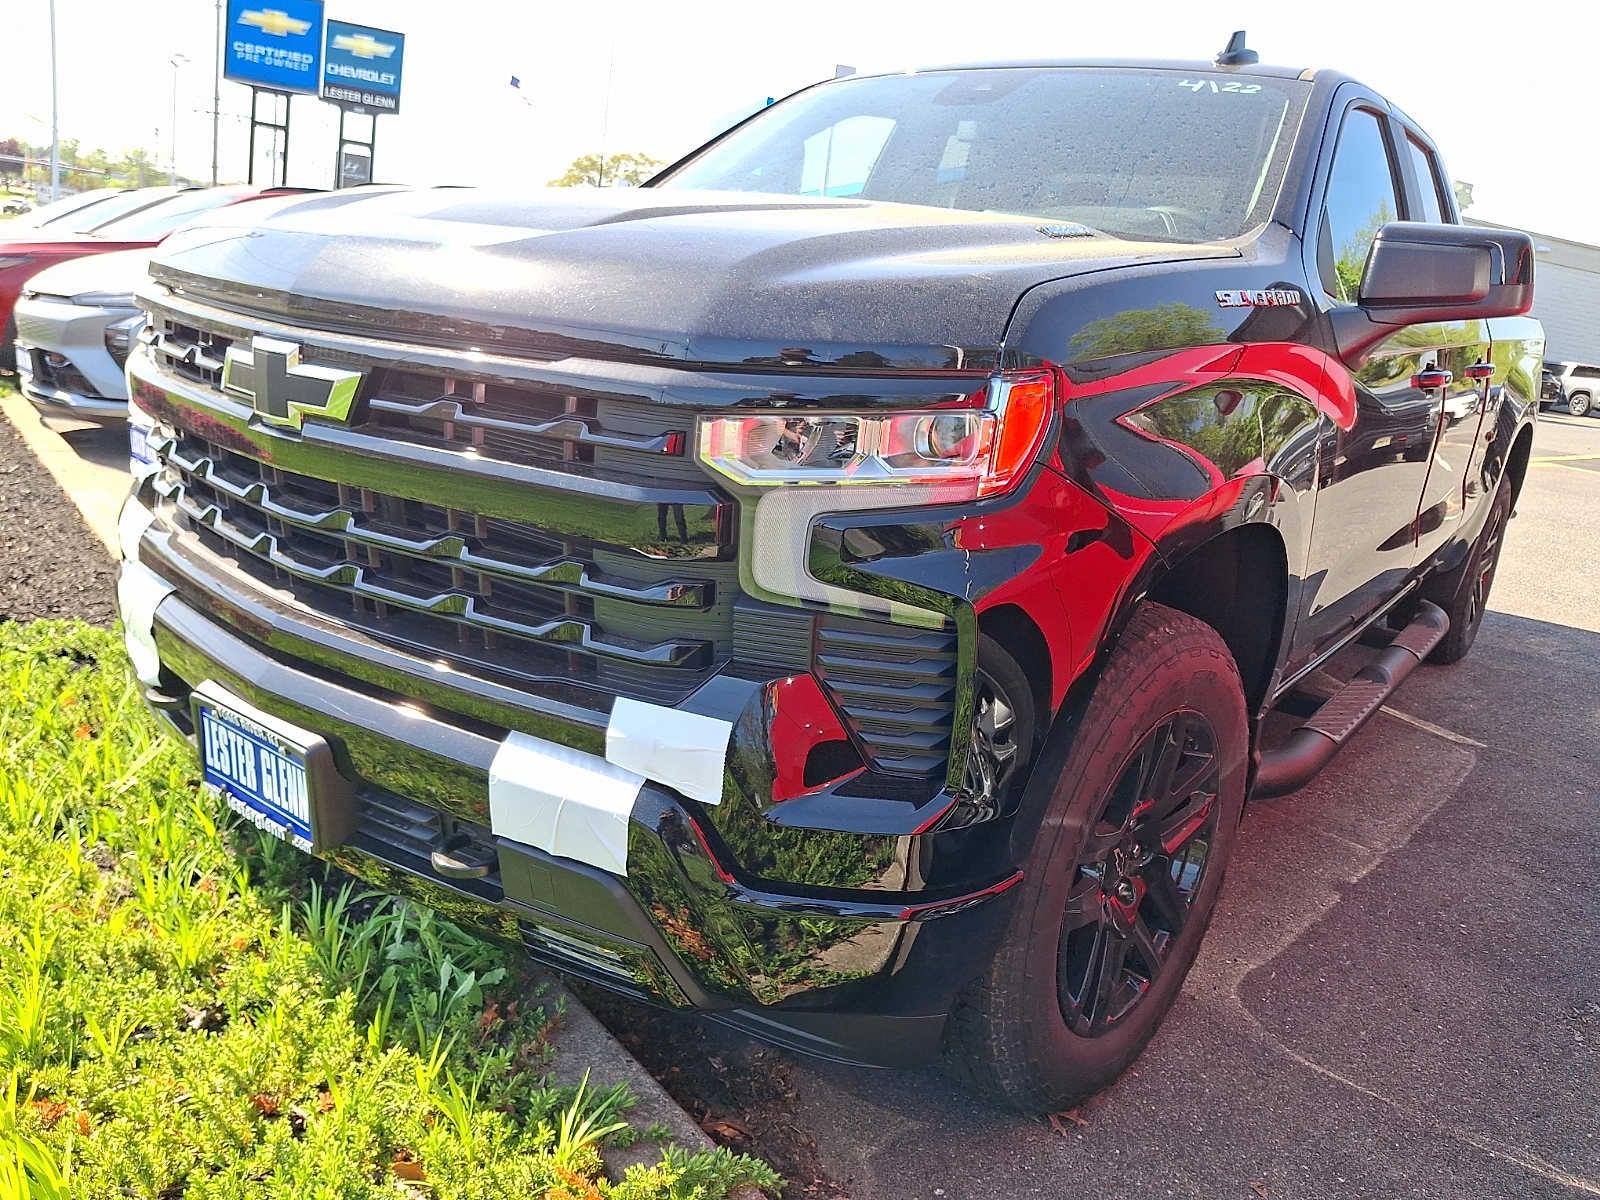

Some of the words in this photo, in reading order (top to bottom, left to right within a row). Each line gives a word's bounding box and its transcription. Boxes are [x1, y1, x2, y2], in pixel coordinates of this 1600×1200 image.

[233, 41, 313, 64] CERTIFIED
[236, 51, 309, 72] PRE-OWNED
[326, 63, 395, 85] CHEVROLET
[324, 86, 361, 103] LESTER
[362, 93, 396, 109] GLENN
[203, 716, 258, 793] LESTER
[260, 748, 310, 825] GLENN
